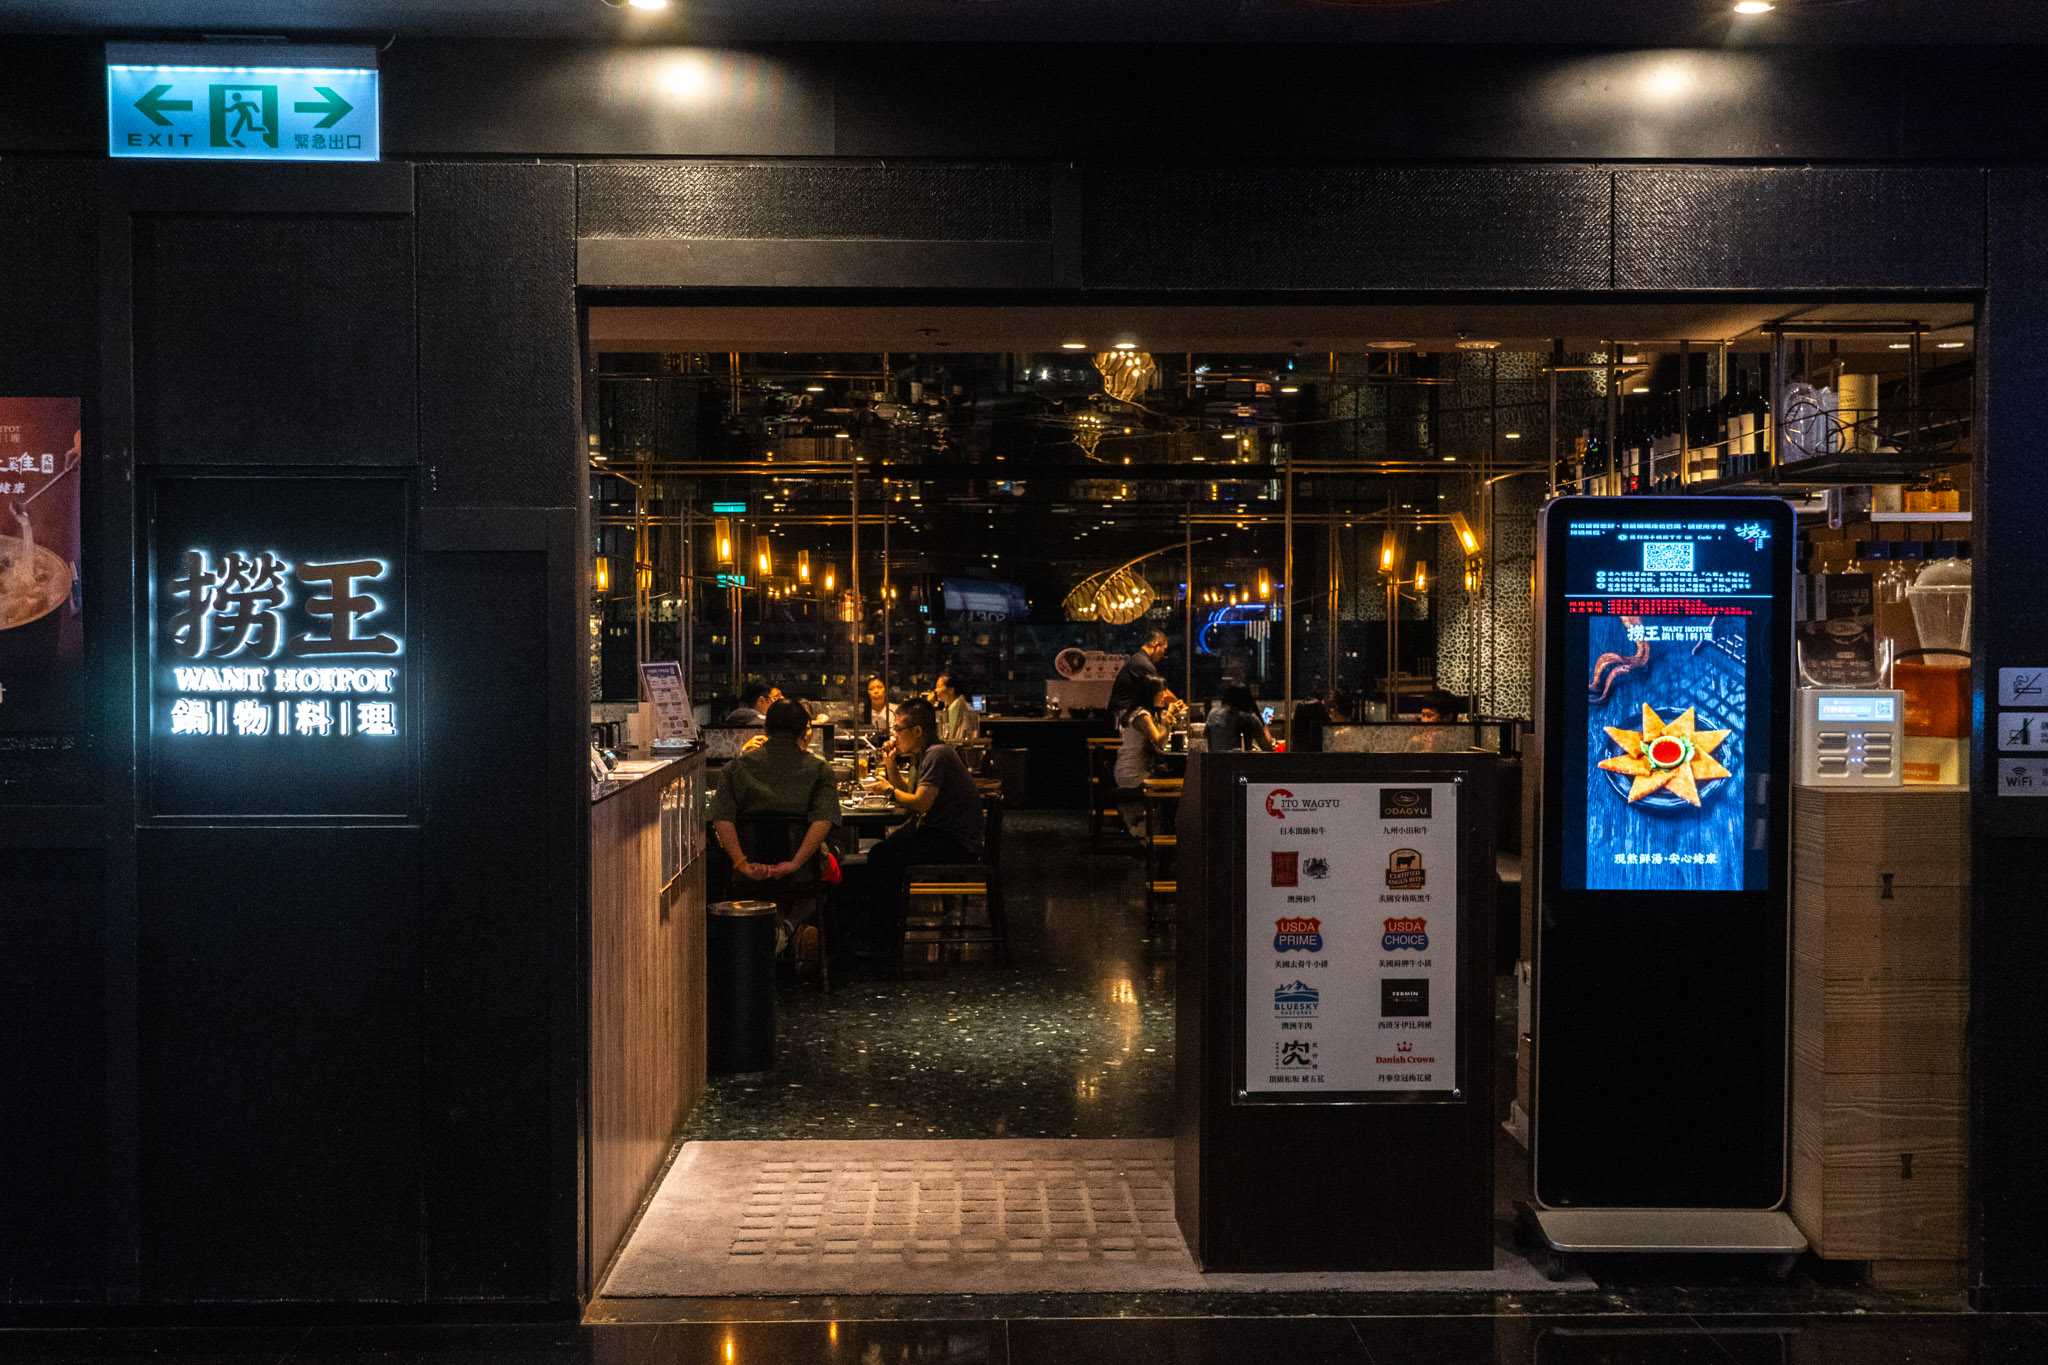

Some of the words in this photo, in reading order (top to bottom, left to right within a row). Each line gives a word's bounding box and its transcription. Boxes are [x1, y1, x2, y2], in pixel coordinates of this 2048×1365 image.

[127, 133, 193, 147] EXIT
[295, 134, 361, 149] 緊急出口
[170, 549, 403, 659] 撈王
[1627, 624, 1660, 641] 撈王
[173, 667, 269, 692] WANT
[274, 667, 398, 692] HOTPOT
[2006, 776, 2032, 787] WiFi
[1281, 799, 1298, 808] ITO
[1302, 799, 1340, 808] WAGYU
[1384, 807, 1427, 815] ODAGYU
[1389, 870, 1421, 879] CERTIFIED
[1280, 922, 1316, 932] USDA
[1388, 921, 1422, 932] USDA
[1278, 935, 1318, 946] PRIME
[1384, 935, 1425, 945] CHOICE
[1375, 1055, 1405, 1063] Danish
